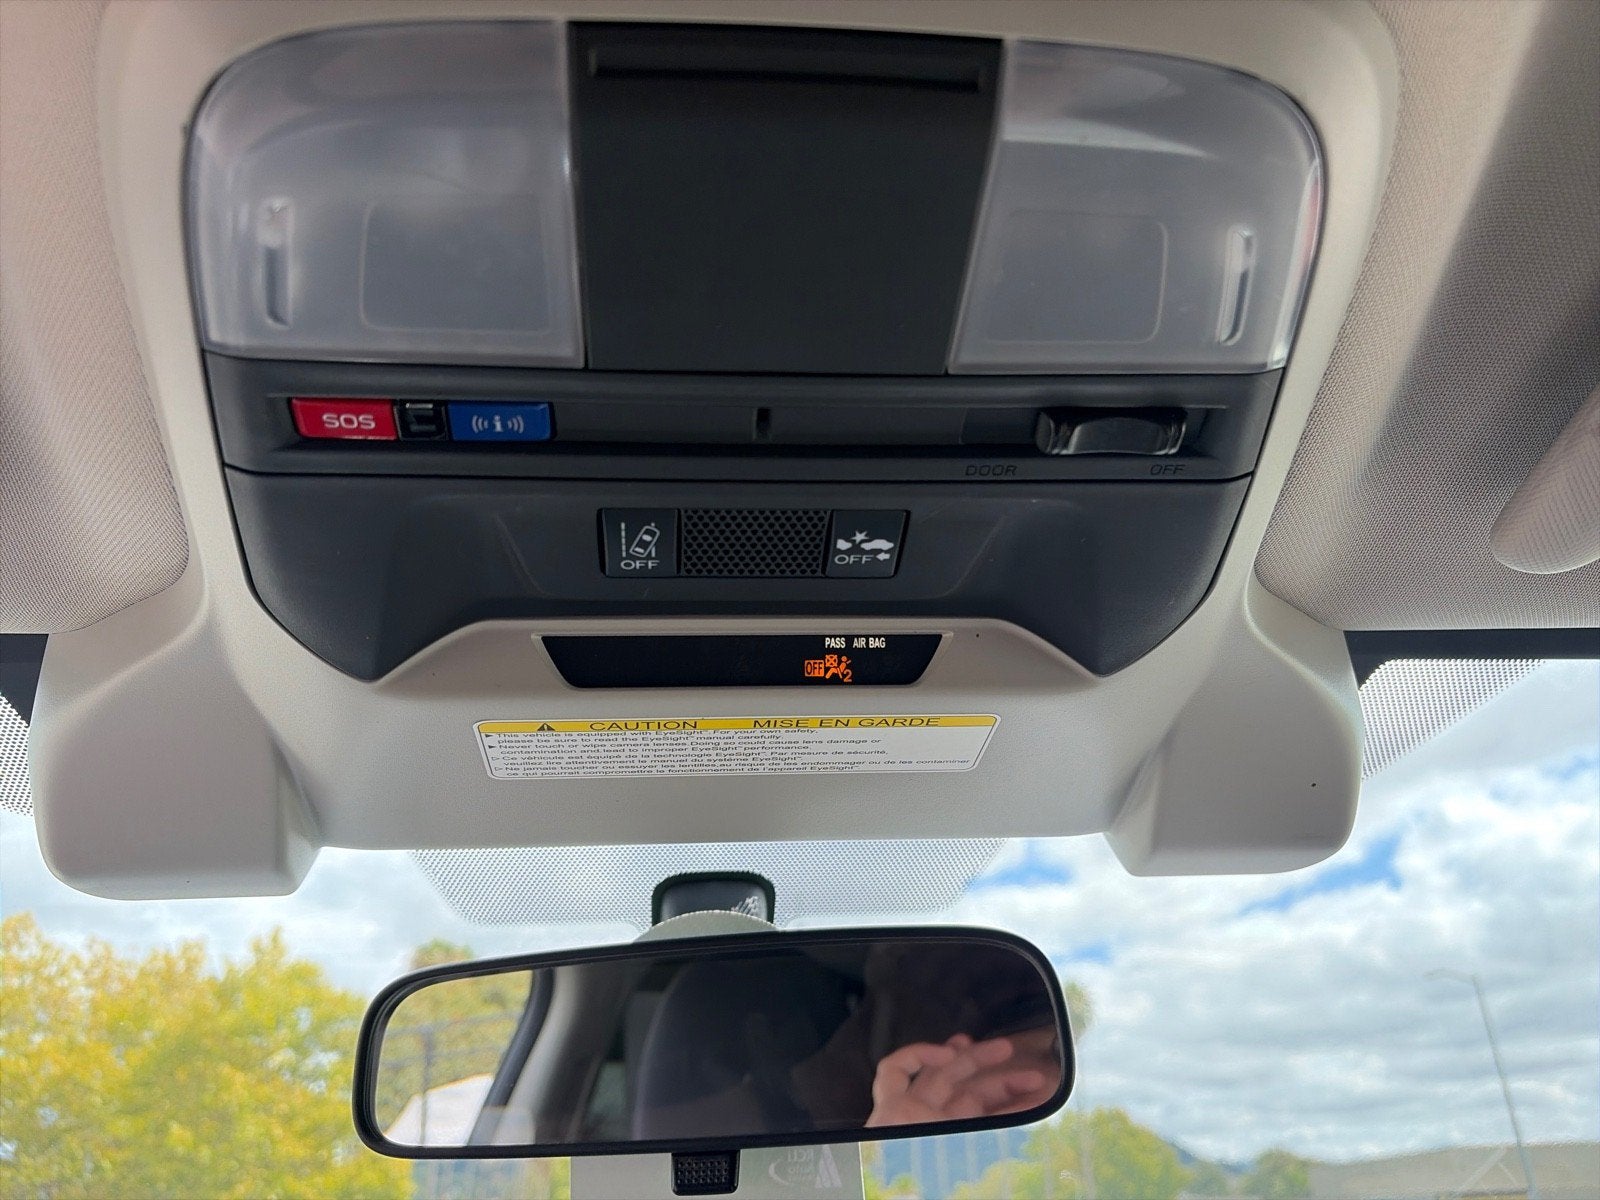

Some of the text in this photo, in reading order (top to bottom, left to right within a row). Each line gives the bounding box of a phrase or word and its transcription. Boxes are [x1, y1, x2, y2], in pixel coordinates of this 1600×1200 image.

[322, 413, 375, 429] SOS
[965, 465, 1017, 476] DOOR
[1150, 464, 1186, 475] OFF
[620, 560, 660, 570] OFF
[834, 555, 874, 564] OFF
[825, 637, 886, 649] PASS AIR BAG
[805, 661, 824, 676] OFF
[590, 721, 697, 730] CAUTION
[753, 718, 940, 728] MISE EN GARDE
